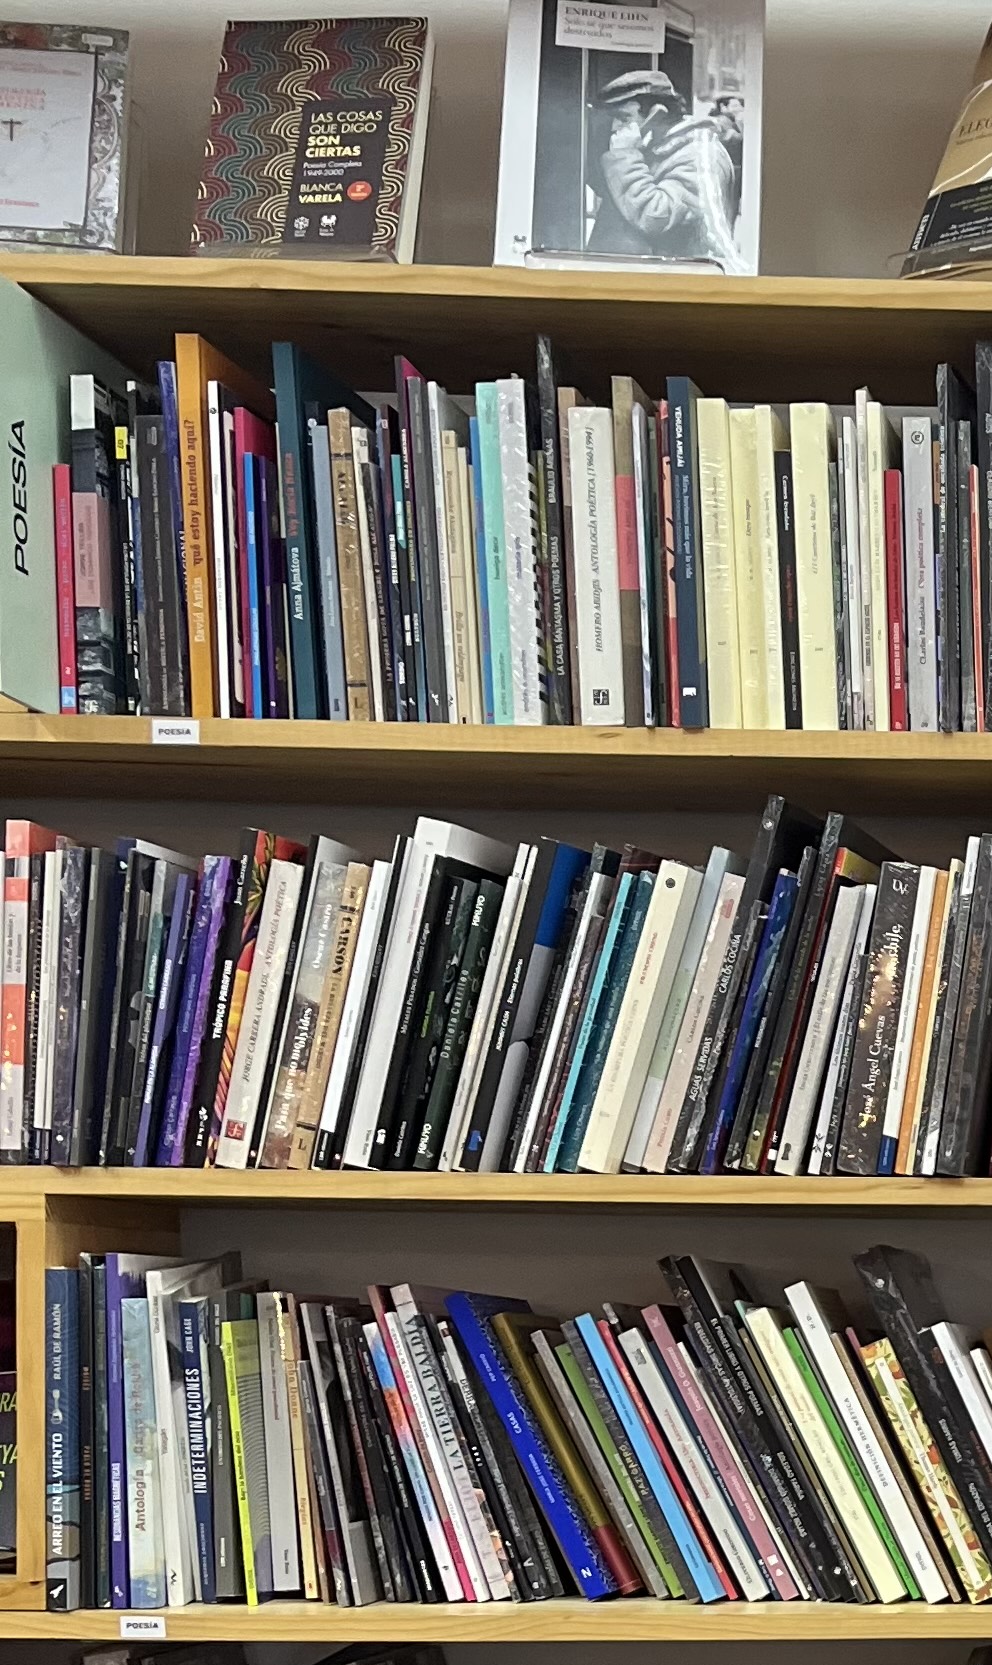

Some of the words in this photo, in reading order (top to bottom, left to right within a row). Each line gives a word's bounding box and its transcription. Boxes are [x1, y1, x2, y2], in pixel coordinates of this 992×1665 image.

[565, 7, 618, 19] ENRIQUE
[310, 124, 337, 134] QUE
[341, 122, 376, 133] DIGO
[311, 112, 333, 123] LAS
[337, 111, 382, 122] COSAS
[306, 146, 360, 158] CIERTAS
[308, 135, 340, 146] SON
[299, 194, 342, 203] VARELA
[300, 183, 343, 192] BLANCA
[183, 420, 197, 450] aquí?
[186, 454, 198, 506] haciendo
[8, 420, 29, 576] POESÍA
[189, 510, 200, 540] estoy
[290, 547, 303, 591] Ajmátova
[294, 595, 304, 620] Anna
[195, 612, 206, 642] David
[471, 895, 486, 926] KIKUYO
[331, 916, 353, 976] CARSON
[440, 1016, 458, 1058] Daniela
[450, 969, 469, 1015] Catrileo
[417, 1123, 433, 1154] KIKUYO
[404, 1315, 438, 1380] BALDÍA
[429, 1383, 458, 1447] TIERRA
[185, 1367, 207, 1494] INDETERMINACIONES
[52, 1433, 63, 1478] VIENTO
[449, 1449, 464, 1471] LA
[52, 1480, 63, 1494] EL
[134, 1469, 146, 1531] Antología
[52, 1496, 63, 1511] EN
[52, 1514, 63, 1555] ARREO
